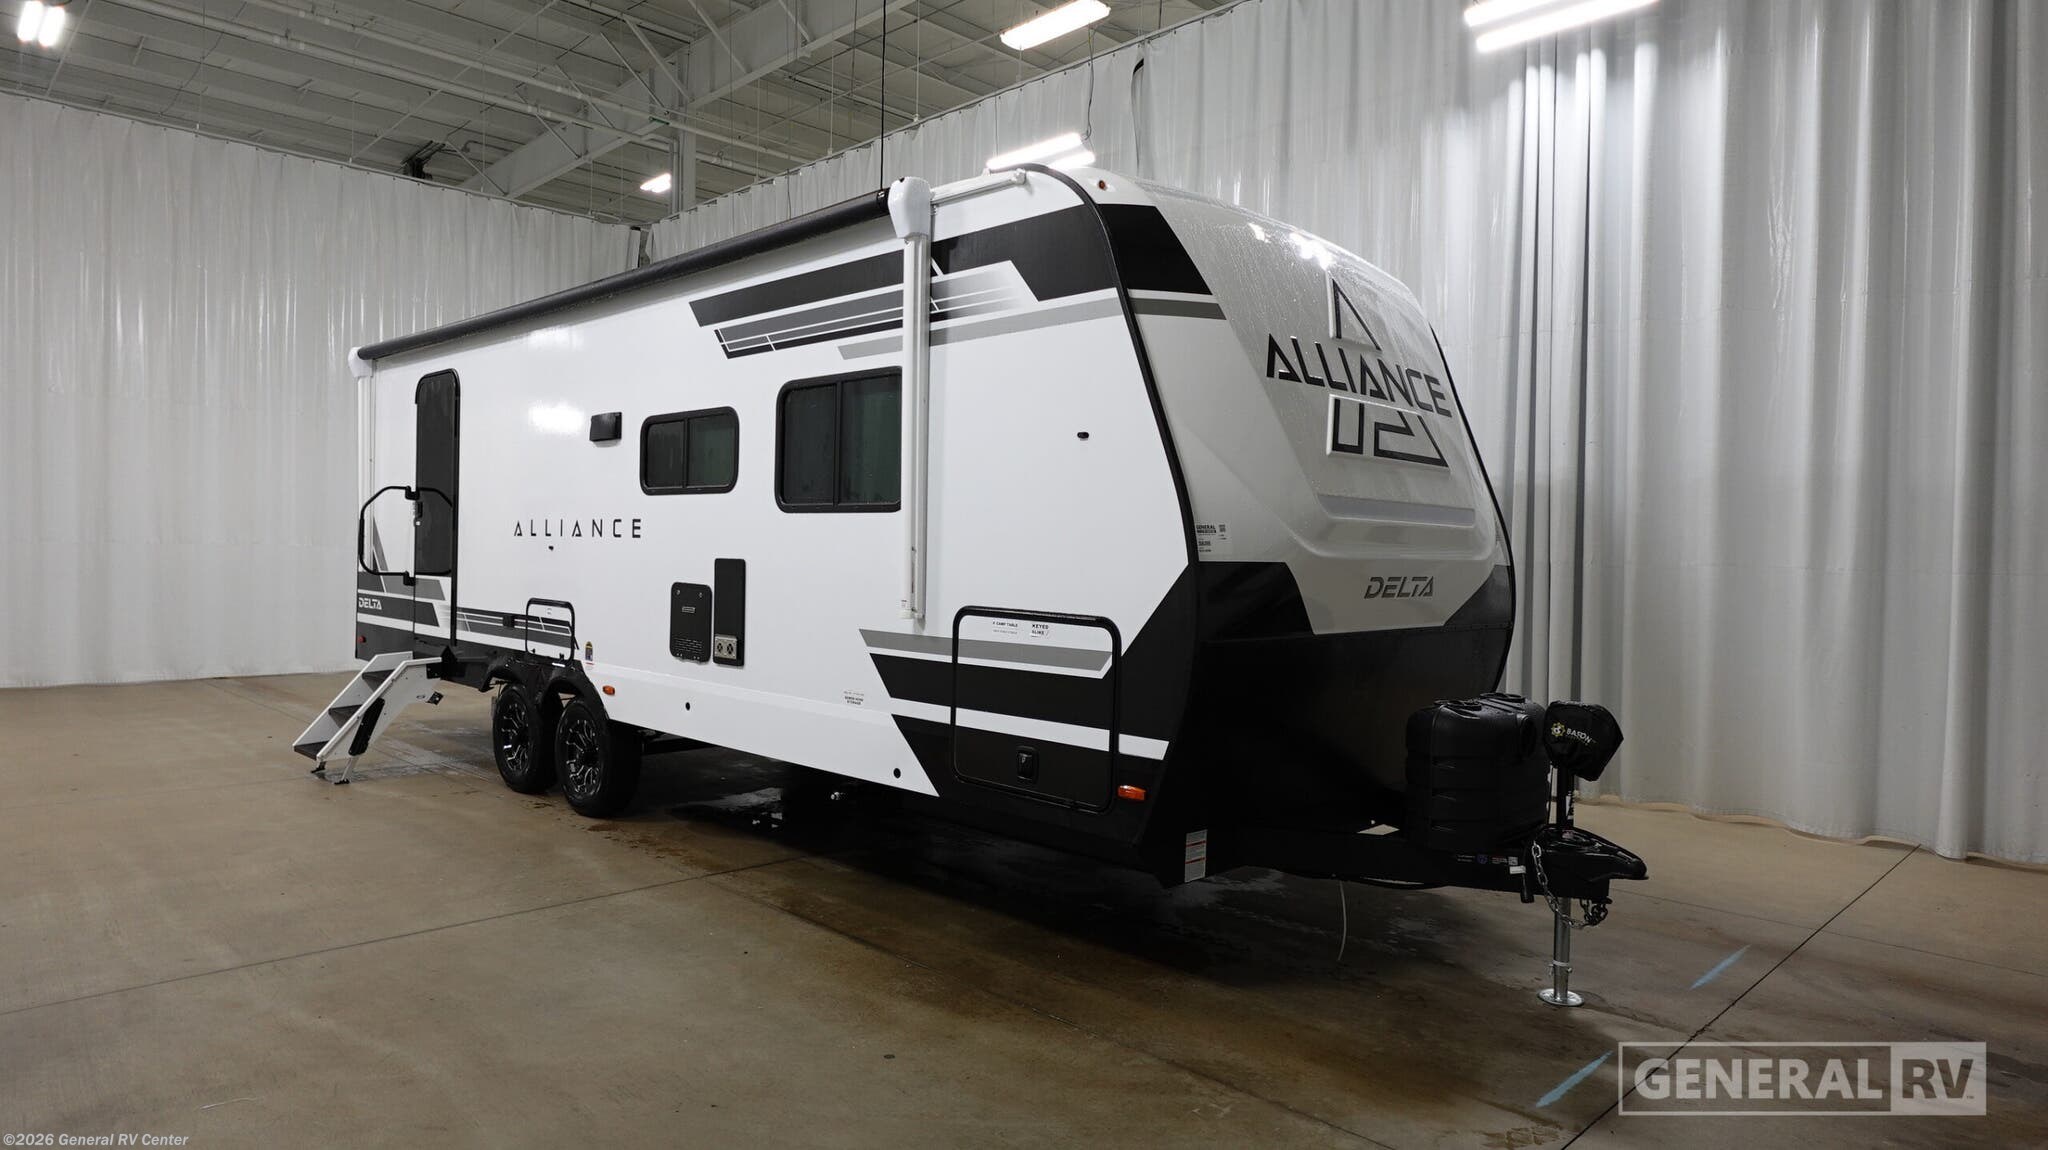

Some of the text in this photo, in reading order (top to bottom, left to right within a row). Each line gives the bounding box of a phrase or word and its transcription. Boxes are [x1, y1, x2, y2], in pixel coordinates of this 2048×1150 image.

[1266, 333, 1452, 418] ALLIANCE
[513, 518, 642, 539] ALLIANCE
[1364, 576, 1434, 599] DELTA
[358, 597, 382, 610] DELTA
